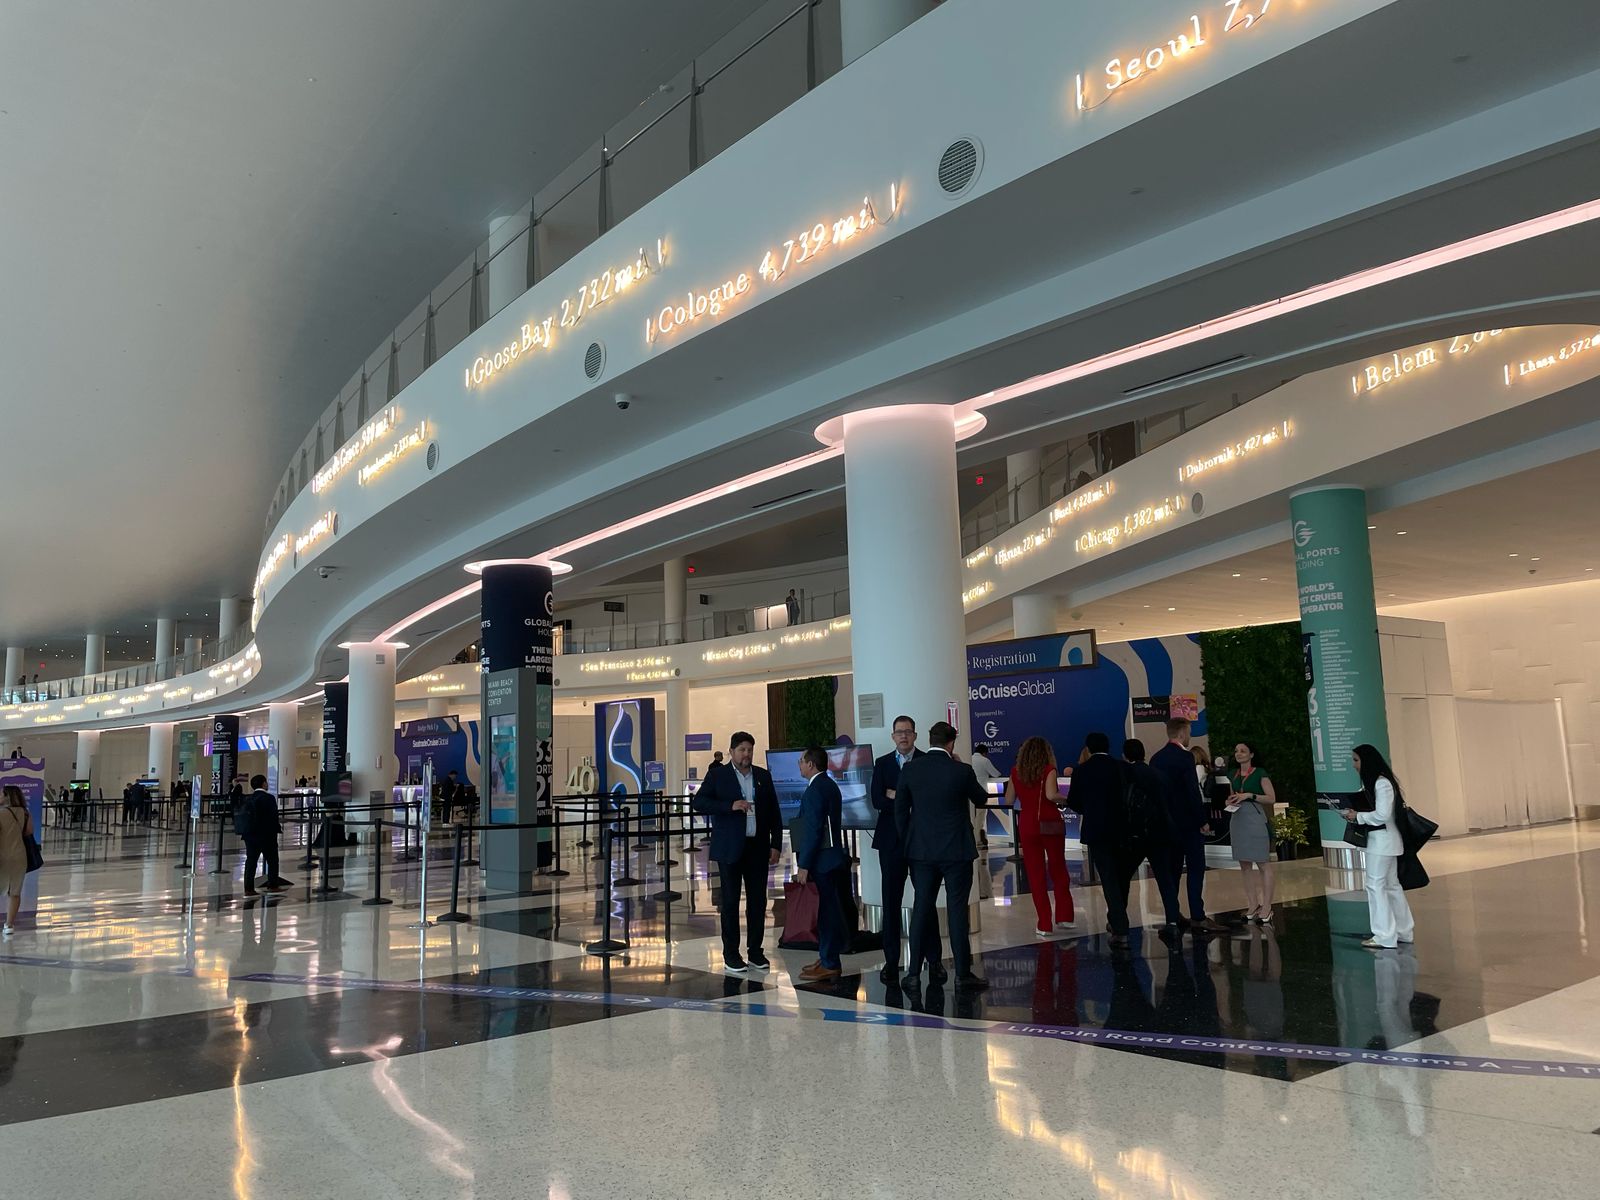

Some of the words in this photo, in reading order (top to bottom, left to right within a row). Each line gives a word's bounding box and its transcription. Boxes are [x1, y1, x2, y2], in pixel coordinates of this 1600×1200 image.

[1106, 15, 1206, 90] Seoul
[658, 273, 748, 333] Cologne
[758, 223, 825, 281] 4,739
[560, 271, 611, 328] 2,732
[1559, 337, 1591, 360] 8,572
[1364, 346, 1436, 391] Belem
[1186, 446, 1233, 478] Dubrovnik
[1080, 526, 1120, 550] Chicago
[1124, 507, 1152, 535] 1,382
[1306, 546, 1341, 558] PORTS
[1310, 591, 1343, 603] CRUISE
[706, 651, 728, 661] Mexico
[728, 647, 743, 659] City
[972, 651, 1036, 670] Registration
[585, 662, 599, 672] San
[600, 660, 634, 671] Francisco
[487, 687, 512, 698] CONVENTION
[500, 678, 513, 687] BEACH
[487, 697, 502, 706] CENTER
[566, 766, 596, 795] 40
[1007, 1025, 1098, 1038] Lincoln
[1105, 1033, 1173, 1044] Road
[1180, 1038, 1352, 1058] Conference
[1360, 1052, 1468, 1067] Rooms
[1479, 1061, 1502, 1070] A
[1543, 1064, 1567, 1074] H
